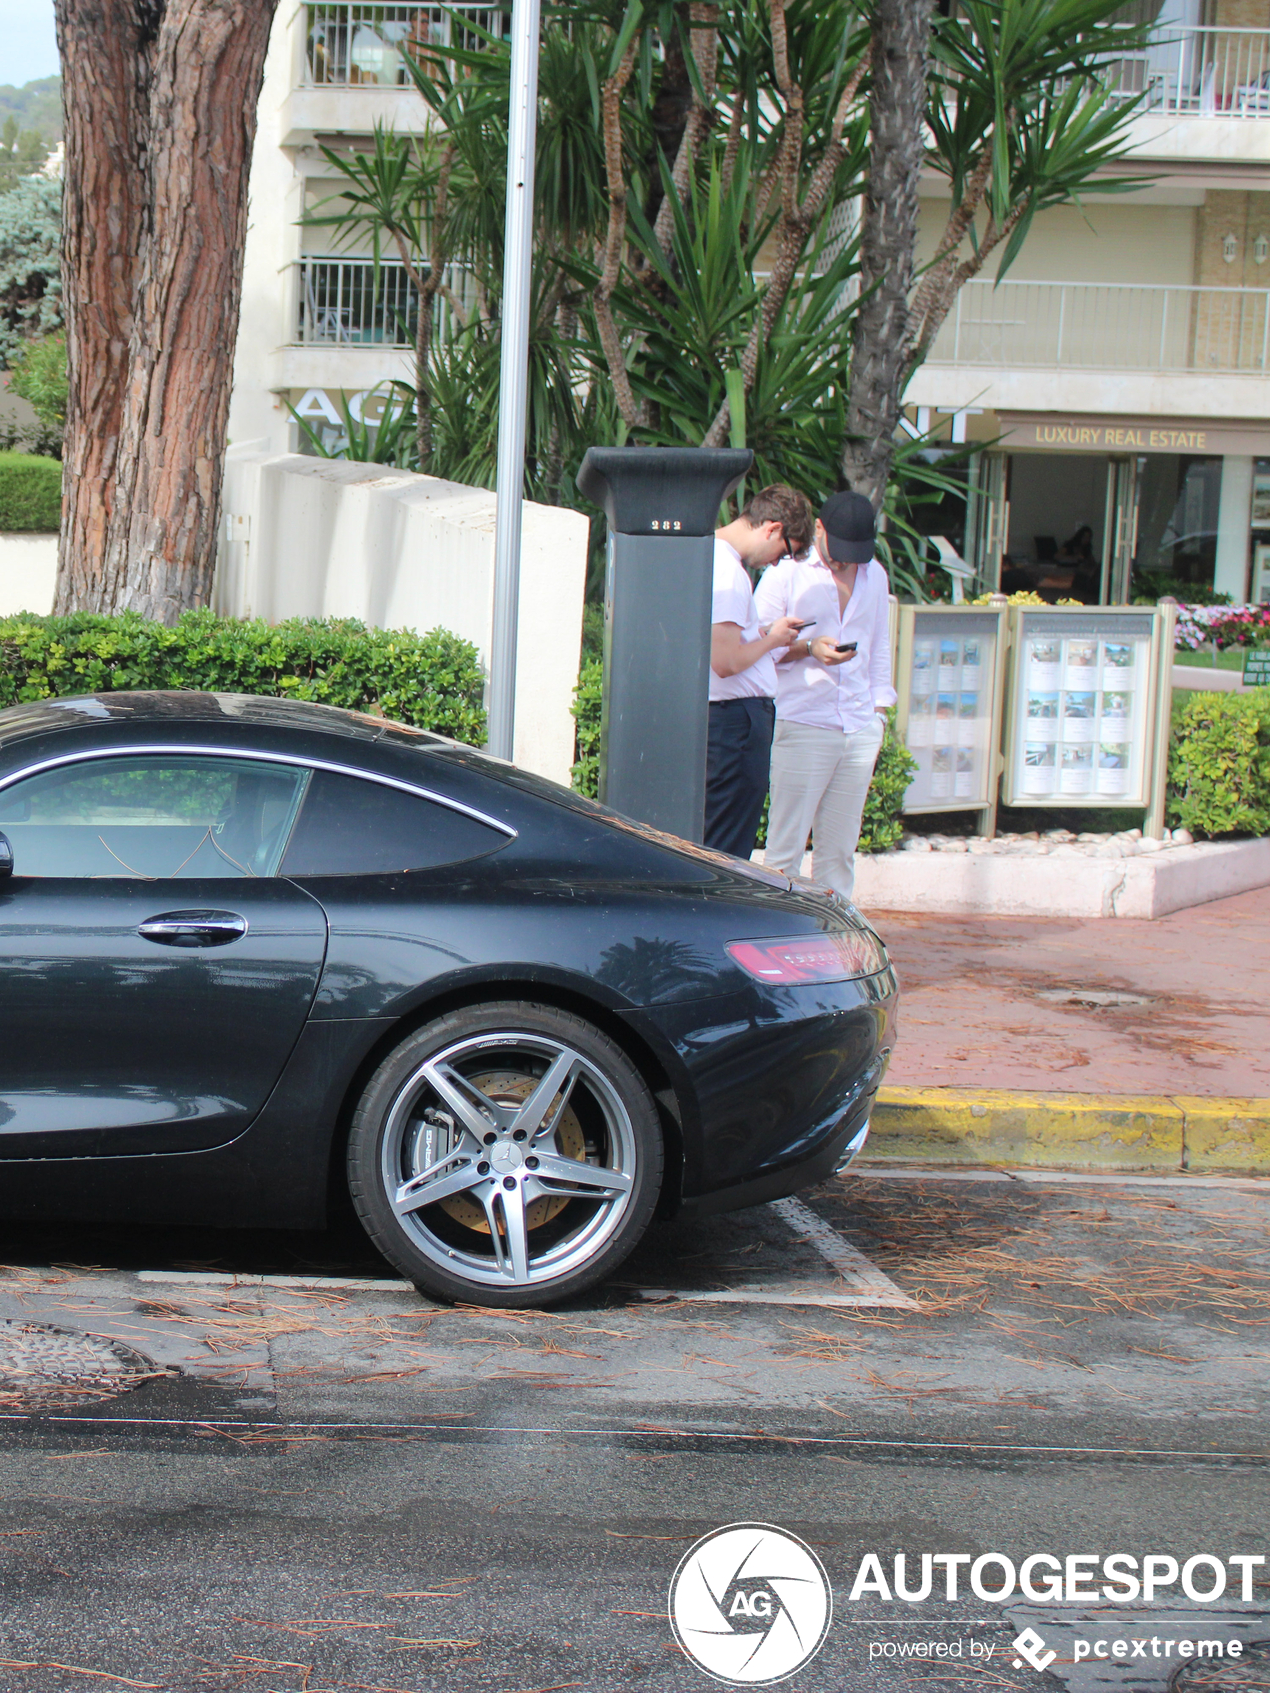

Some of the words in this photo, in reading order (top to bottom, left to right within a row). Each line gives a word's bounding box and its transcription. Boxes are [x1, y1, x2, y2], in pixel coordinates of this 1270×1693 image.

[287, 388, 418, 427] AG
[1035, 426, 1101, 444] LUXURY
[1104, 429, 1145, 446] REAL
[1149, 430, 1206, 448] ESTATE
[651, 520, 681, 530] 282
